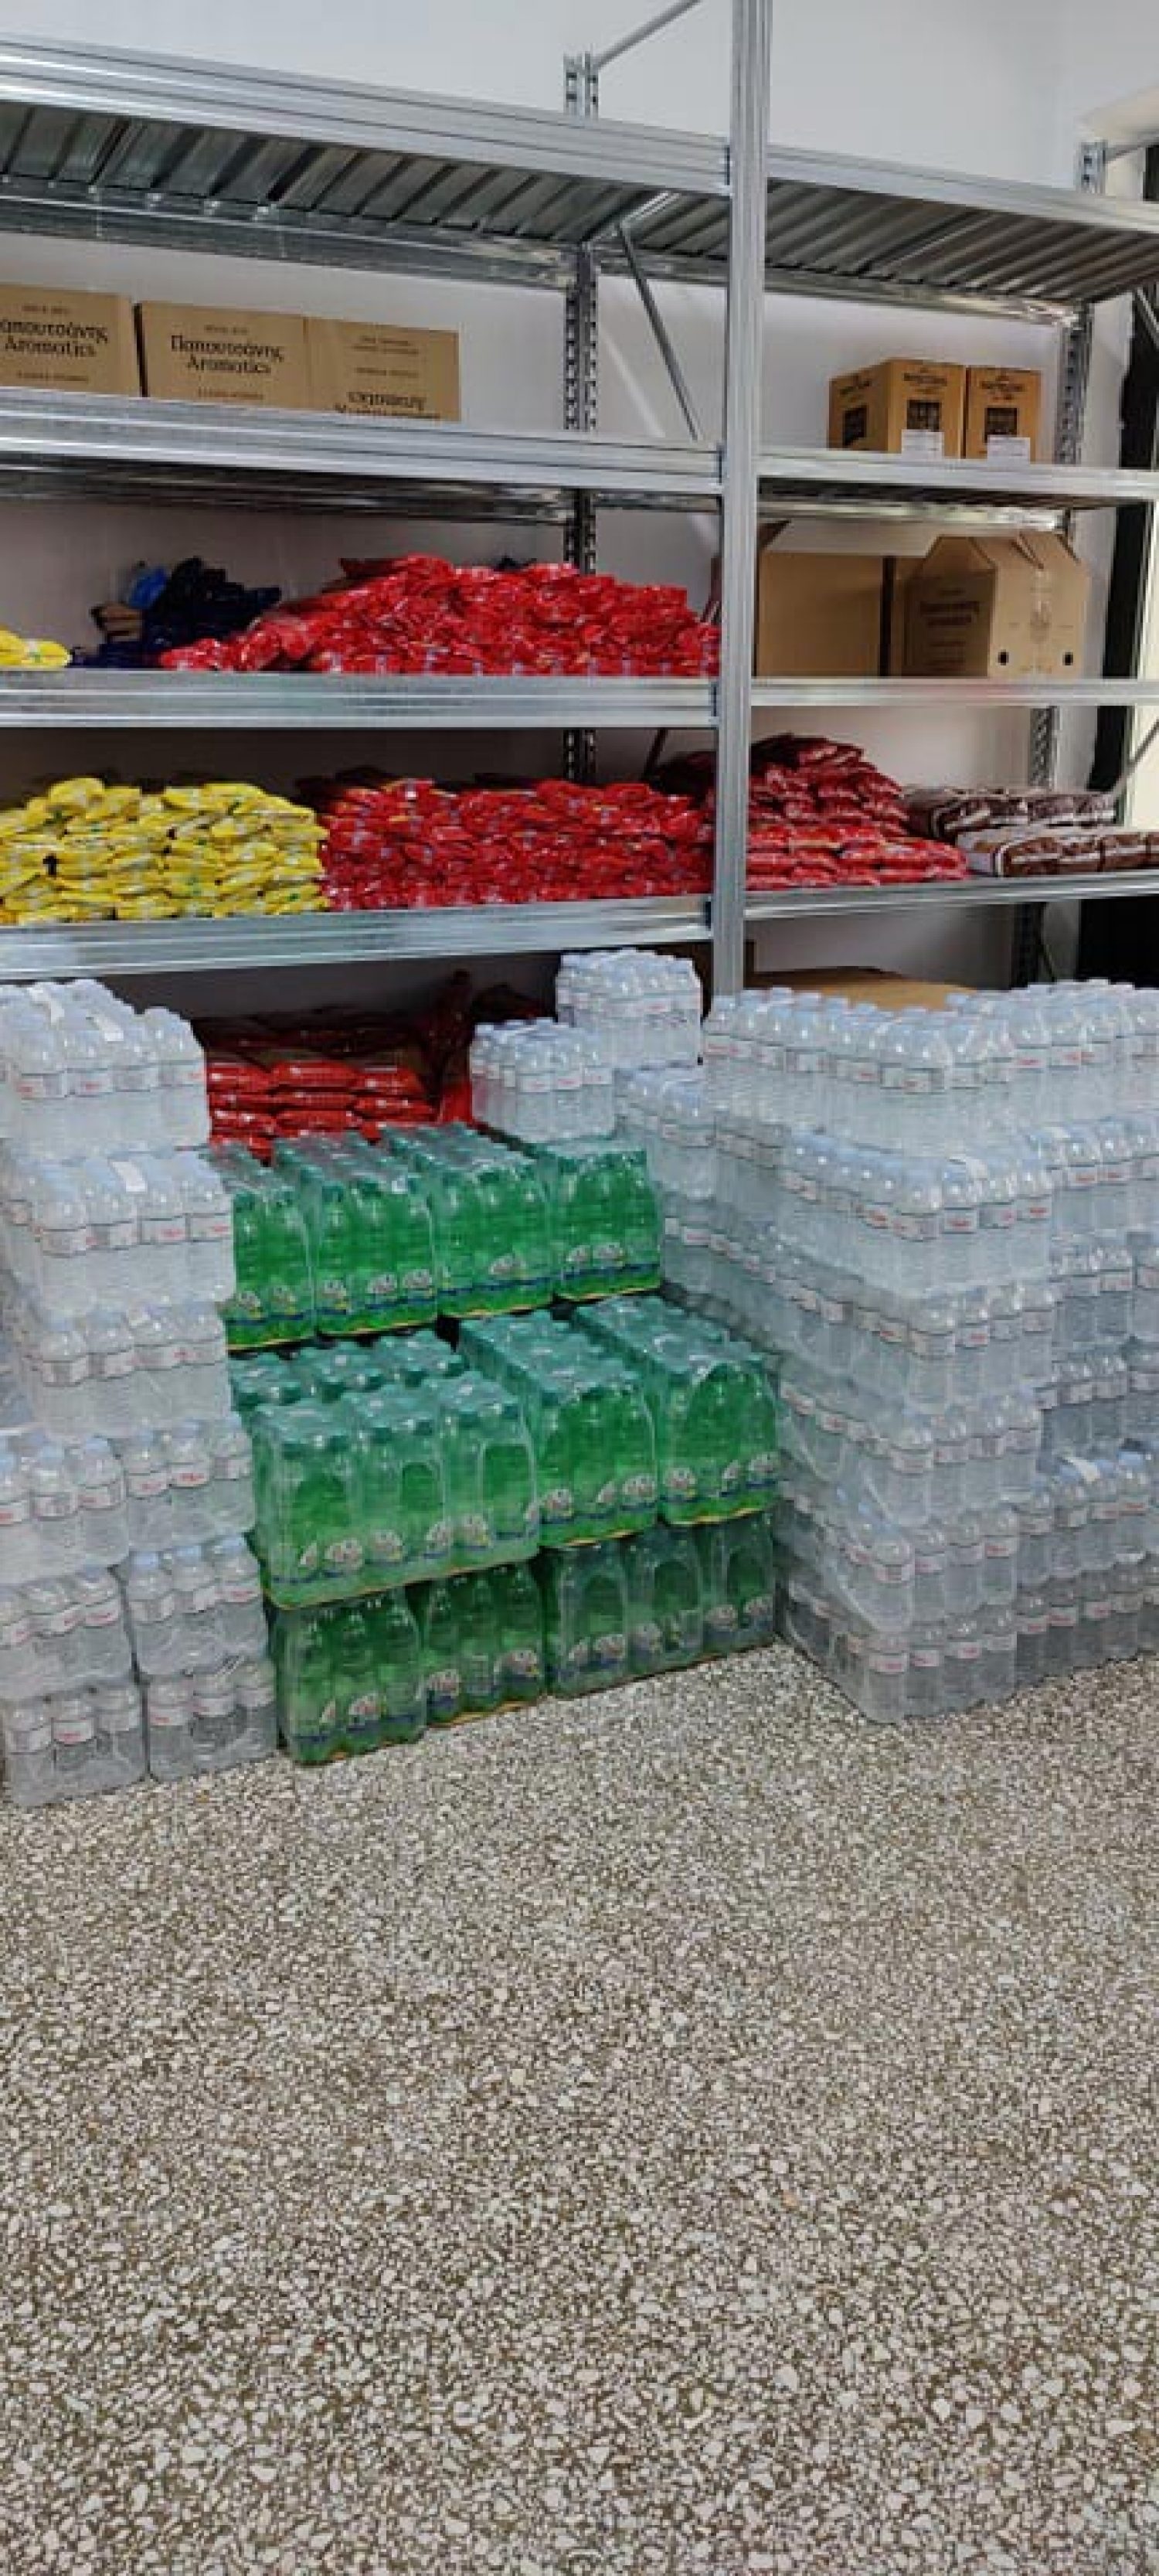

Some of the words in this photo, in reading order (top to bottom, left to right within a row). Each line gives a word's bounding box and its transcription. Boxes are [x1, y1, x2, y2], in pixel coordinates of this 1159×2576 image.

[0, 319, 108, 345] απουτσάνης
[5, 335, 97, 358] Aromatics
[186, 355, 271, 374] Aromatics
